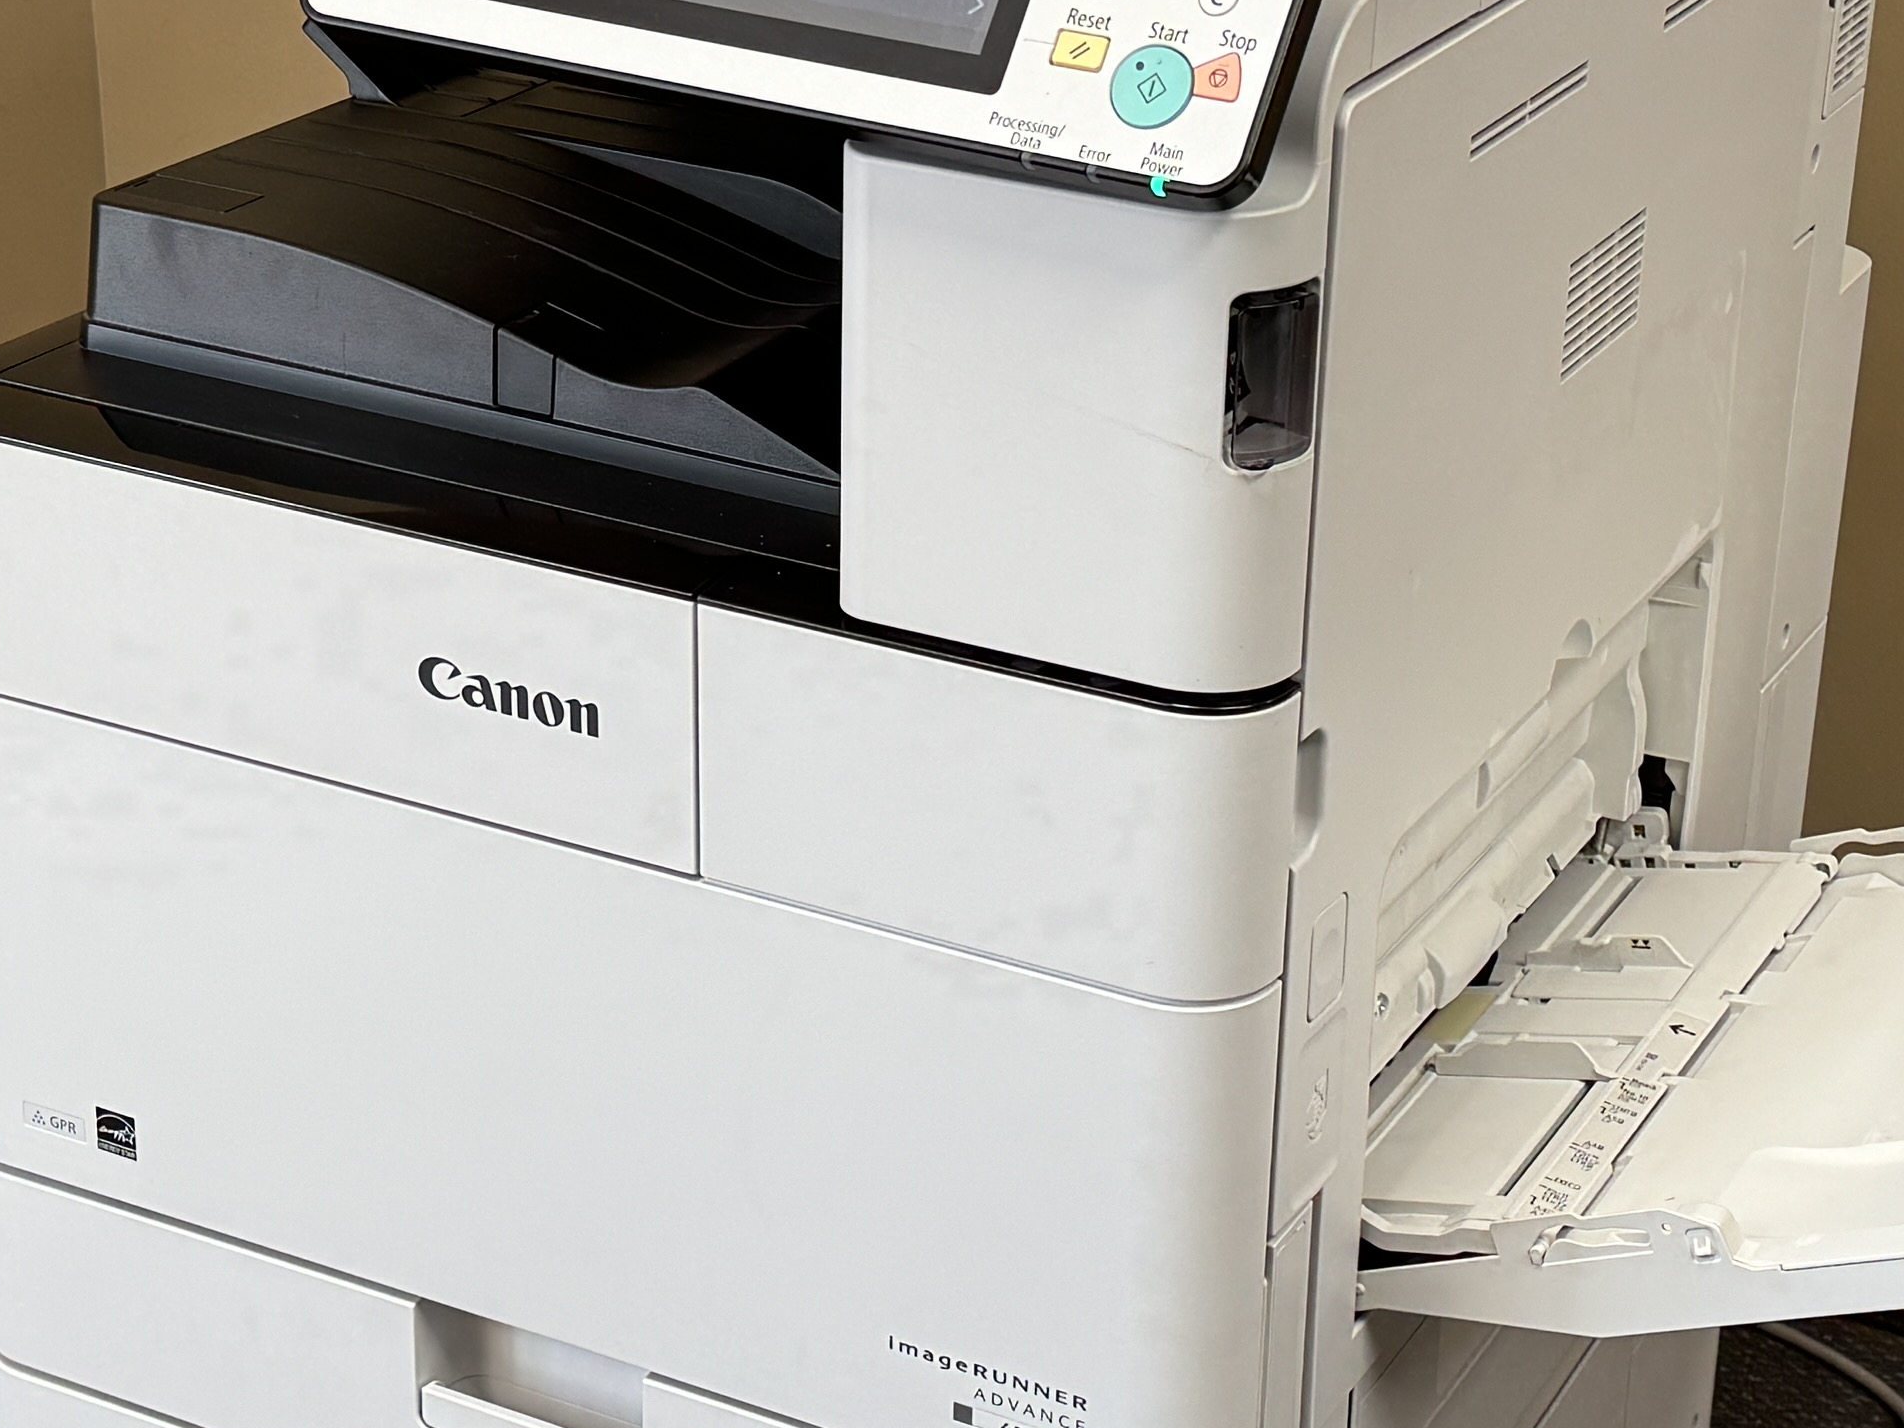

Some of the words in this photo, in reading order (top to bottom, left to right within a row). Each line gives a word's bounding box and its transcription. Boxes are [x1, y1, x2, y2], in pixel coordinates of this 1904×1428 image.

[1066, 8, 1112, 31] Reset
[1148, 21, 1189, 44] Start
[1219, 29, 1257, 54] Stop
[989, 111, 1066, 138] Processing/
[1010, 132, 1042, 150] Data
[1149, 142, 1184, 161] Main
[1078, 144, 1112, 163] Error
[1140, 157, 1184, 177] Power
[418, 656, 599, 739] Canon
[49, 1116, 77, 1134] GPR
